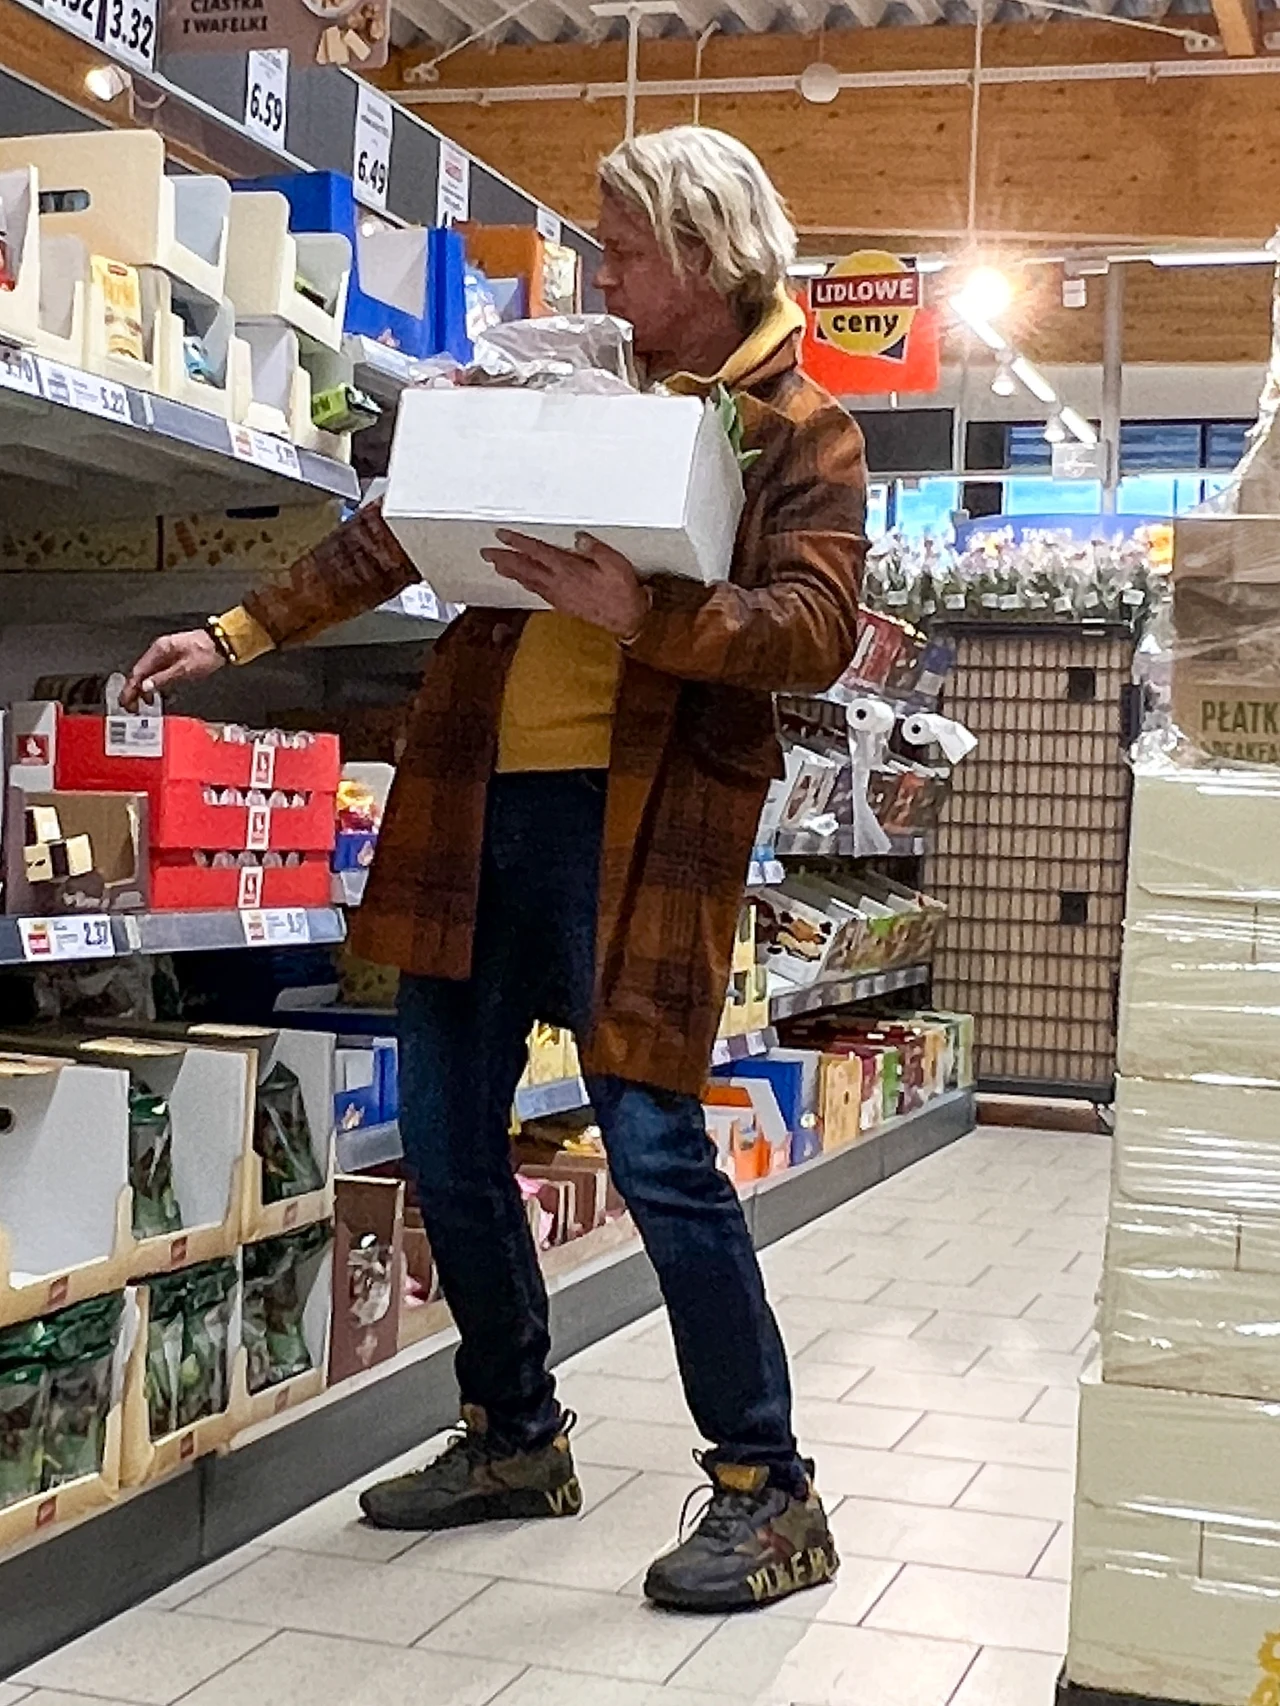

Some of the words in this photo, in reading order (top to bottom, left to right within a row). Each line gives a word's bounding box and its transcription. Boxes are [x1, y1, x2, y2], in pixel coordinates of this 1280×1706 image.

[110, 0, 154, 59] 3.32
[194, 15, 268, 33] WAFELKI
[250, 82, 283, 132] 6.59
[358, 150, 386, 195] 6.49
[816, 277, 914, 304] LIDLOWE
[831, 313, 899, 339] ceny
